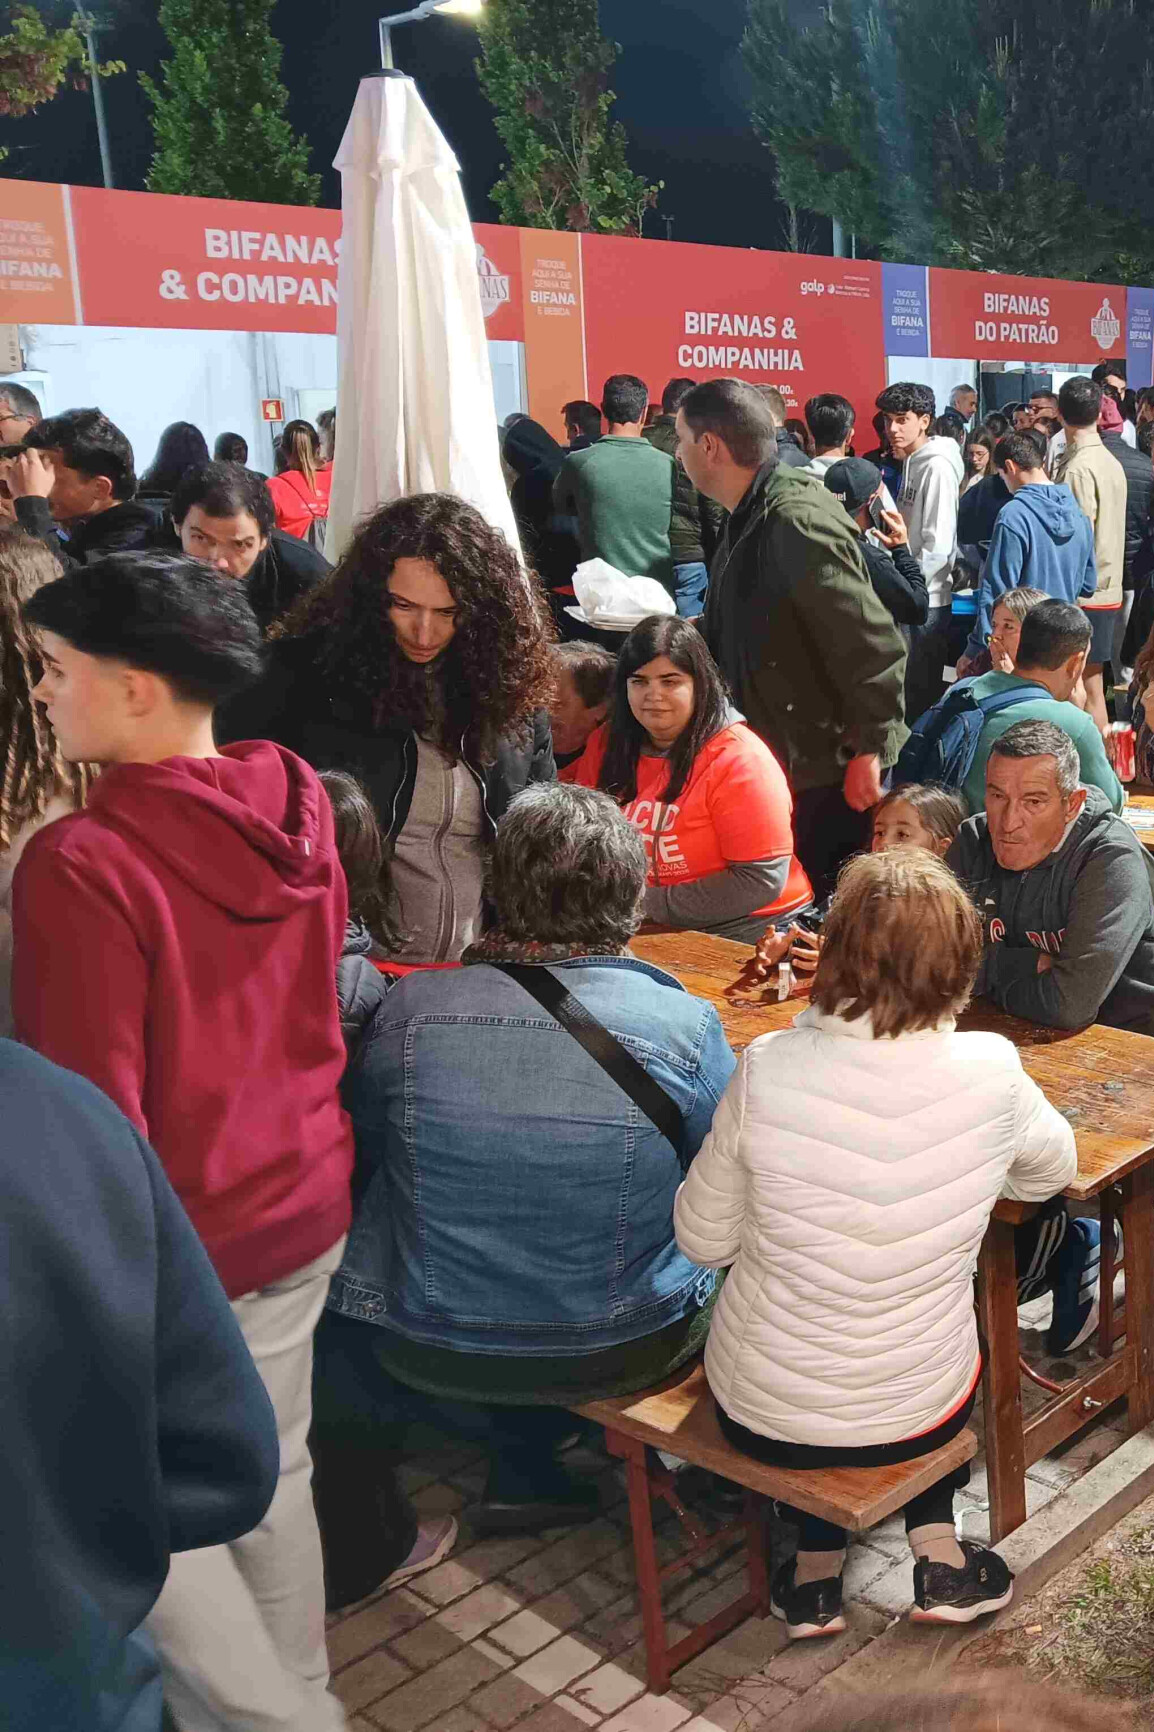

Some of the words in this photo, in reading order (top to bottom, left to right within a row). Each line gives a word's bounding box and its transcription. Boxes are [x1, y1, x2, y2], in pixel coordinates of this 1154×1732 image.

[0, 260, 64, 278] IFANA
[159, 269, 190, 300] &
[197, 271, 339, 305] COMPAN
[530, 290, 576, 305] BIFANA
[800, 279, 825, 296] galp
[984, 292, 1050, 317] BIFANAS
[684, 311, 777, 338] BIFANAS
[781, 317, 797, 339] &
[891, 315, 924, 327] BIFANA
[975, 320, 997, 342] DO
[1000, 319, 1059, 345] PATRÃO
[1129, 330, 1152, 340] BIFANA
[678, 344, 804, 371] COMPANHIA
